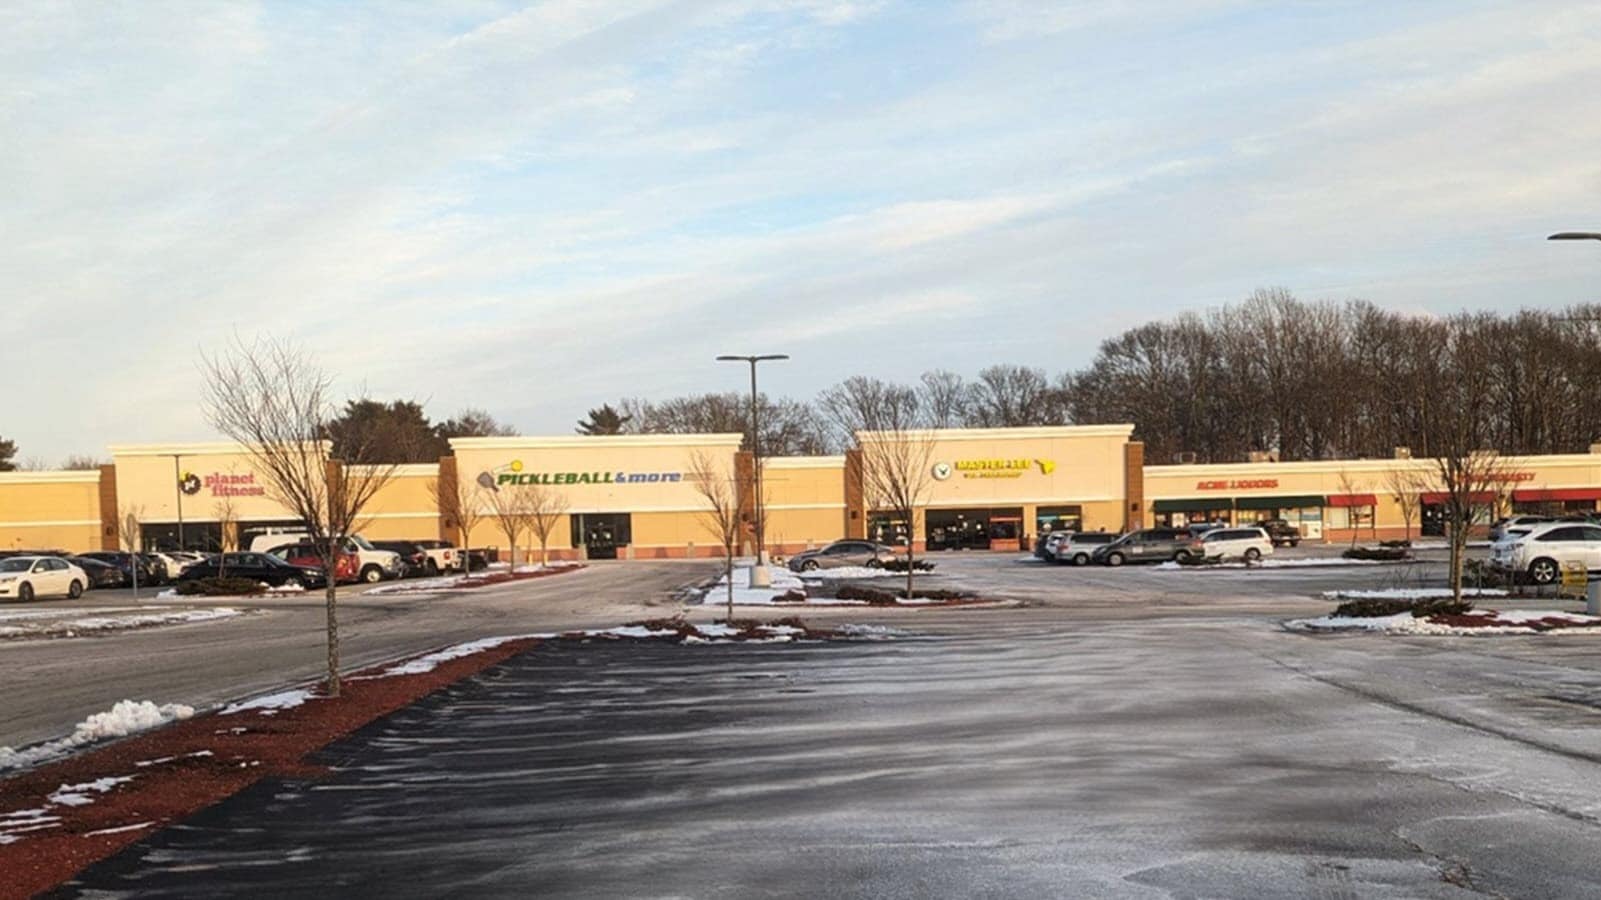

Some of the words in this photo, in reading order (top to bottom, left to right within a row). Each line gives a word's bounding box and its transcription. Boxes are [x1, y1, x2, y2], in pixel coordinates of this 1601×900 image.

[203, 472, 254, 488] planet
[1230, 479, 1279, 489] LIQUORS
[212, 485, 265, 497] fitness
